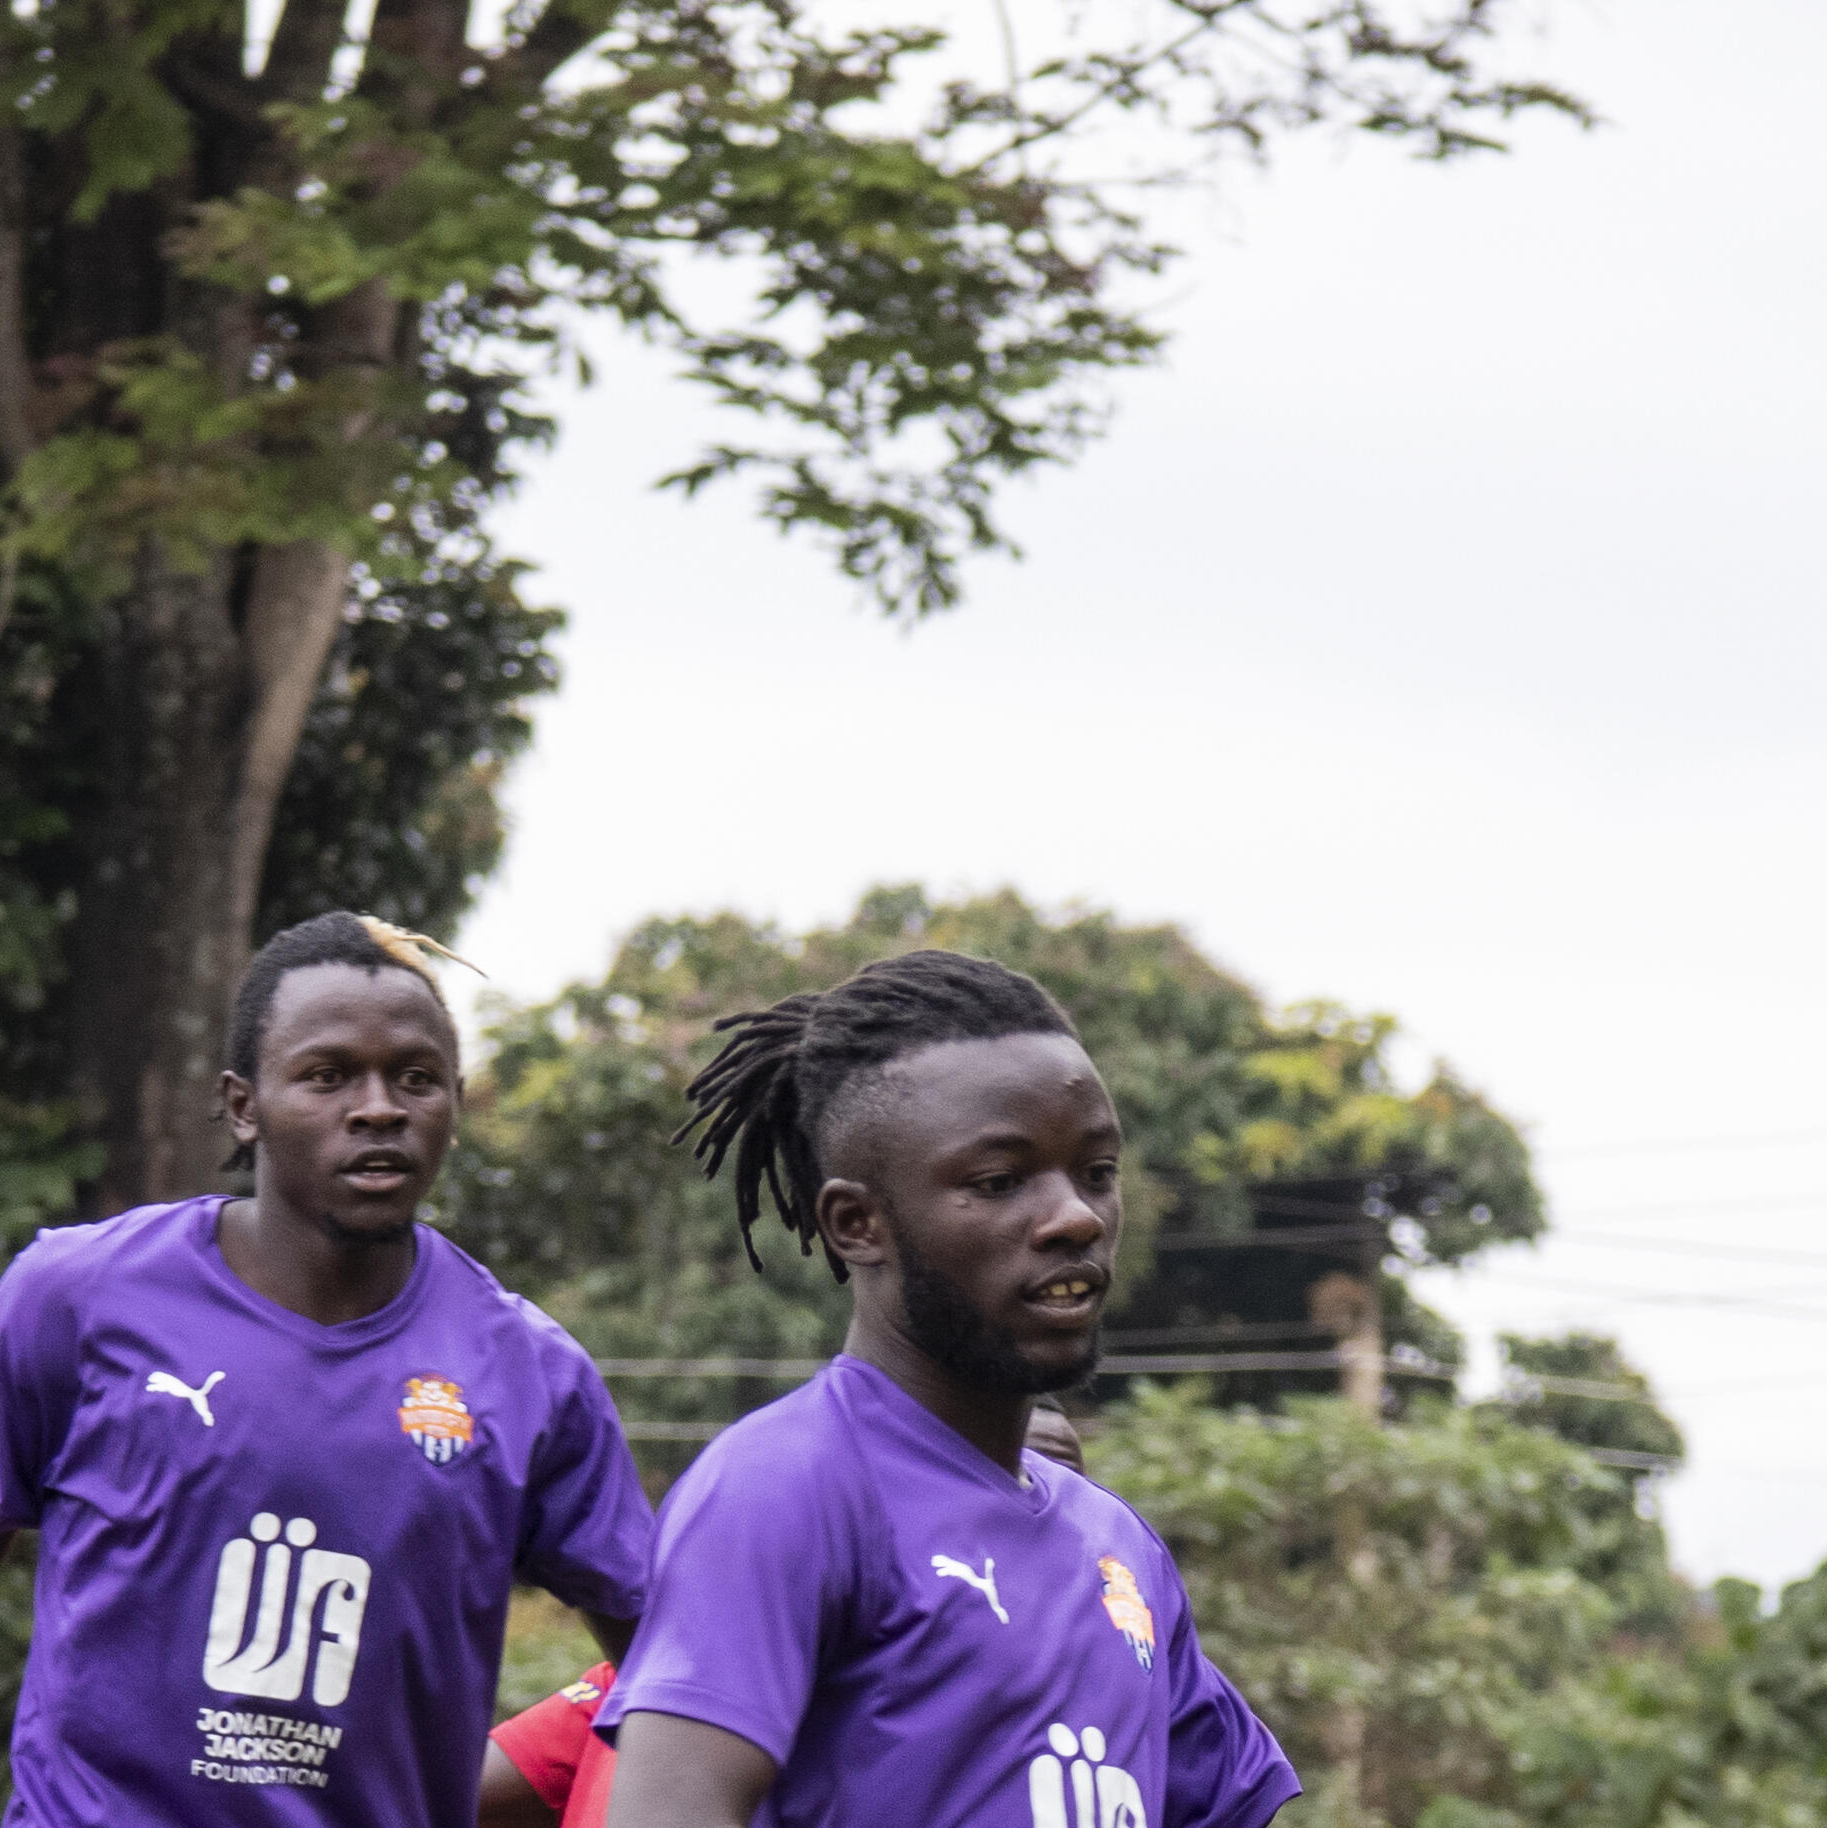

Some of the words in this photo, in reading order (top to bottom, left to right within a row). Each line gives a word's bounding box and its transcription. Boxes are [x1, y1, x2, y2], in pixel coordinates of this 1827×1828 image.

[196, 1707, 343, 1749] JONATHAN
[204, 1733, 328, 1767] JACKSON
[190, 1758, 329, 1788] FOUNDATION
